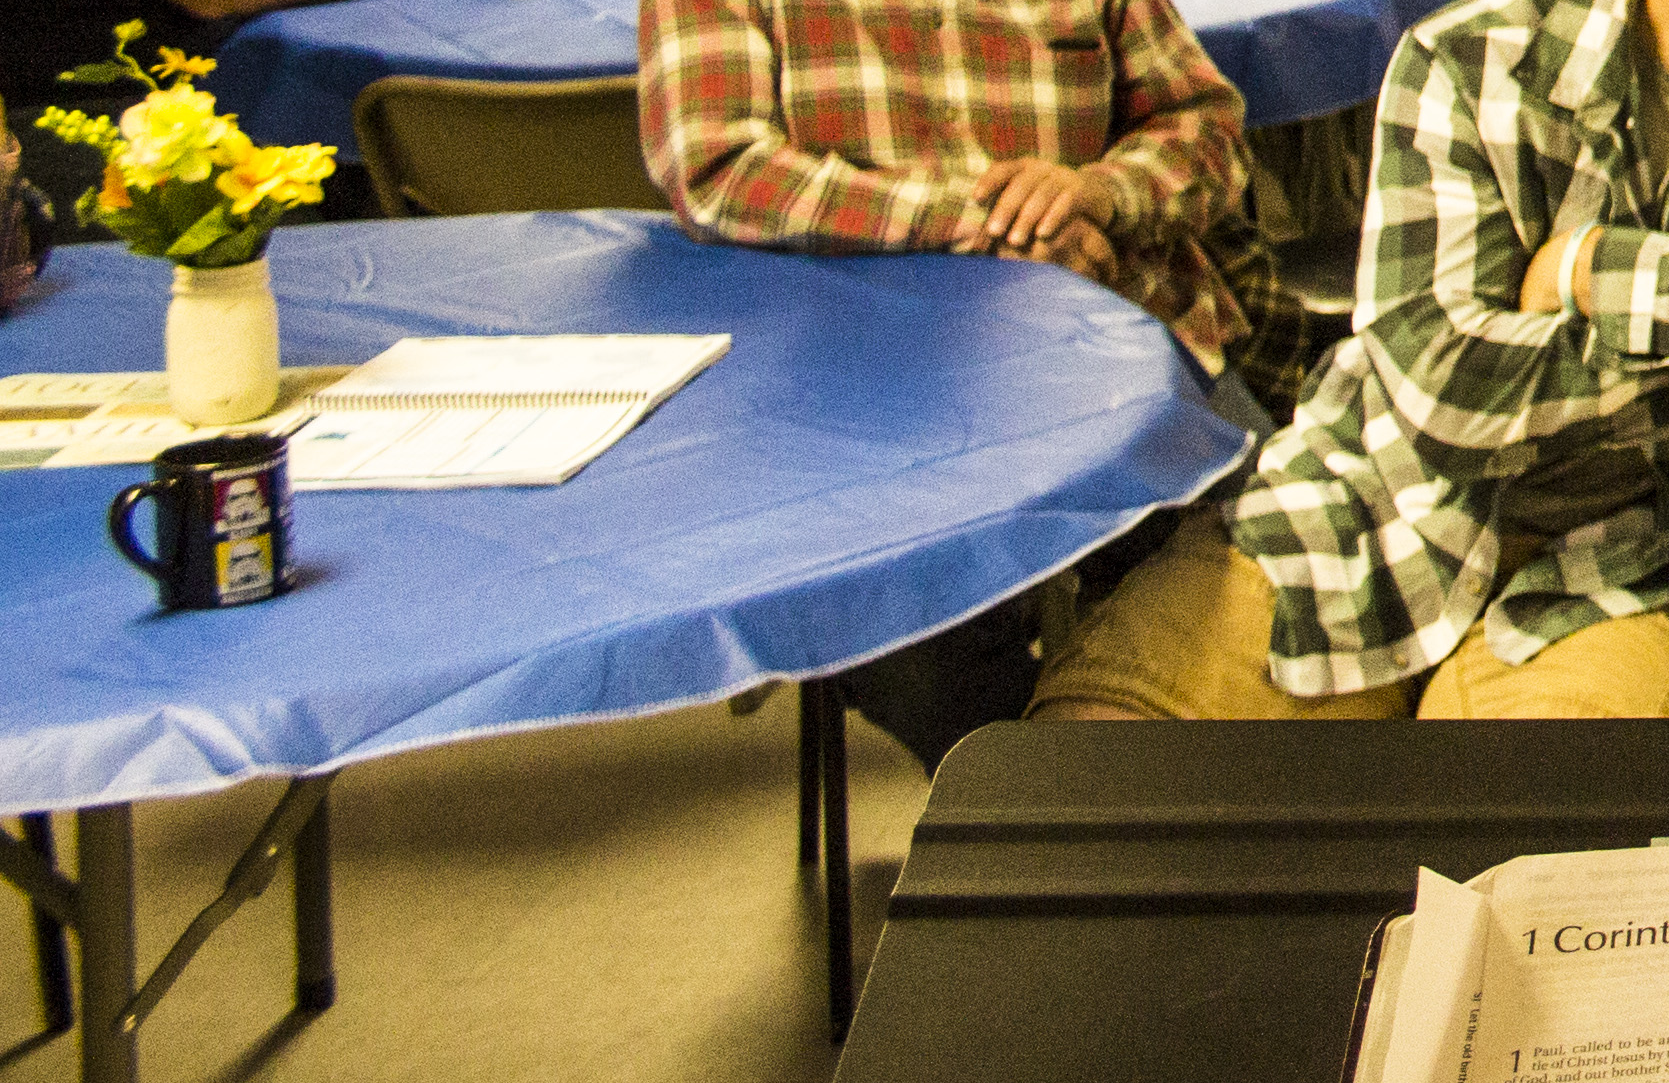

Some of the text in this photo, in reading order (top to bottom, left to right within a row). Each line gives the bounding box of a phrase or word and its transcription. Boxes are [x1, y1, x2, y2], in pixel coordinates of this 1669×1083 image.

[1522, 928, 1537, 955] 1
[1533, 1046, 1566, 1057] Paul,
[1573, 1040, 1612, 1053] called
[1637, 1038, 1652, 1047] be
[1511, 1049, 1521, 1073] 1
[1532, 1059, 1548, 1071] tle
[1551, 1058, 1564, 1069] of
[1567, 1054, 1608, 1067] Christ
[1611, 1052, 1645, 1065] Jesus
[1648, 1051, 1664, 1061] by
[1520, 1073, 1551, 1083] God,
[1556, 1072, 1580, 1082] and
[1585, 1071, 1607, 1080] our
[1612, 1065, 1661, 1077] brother
